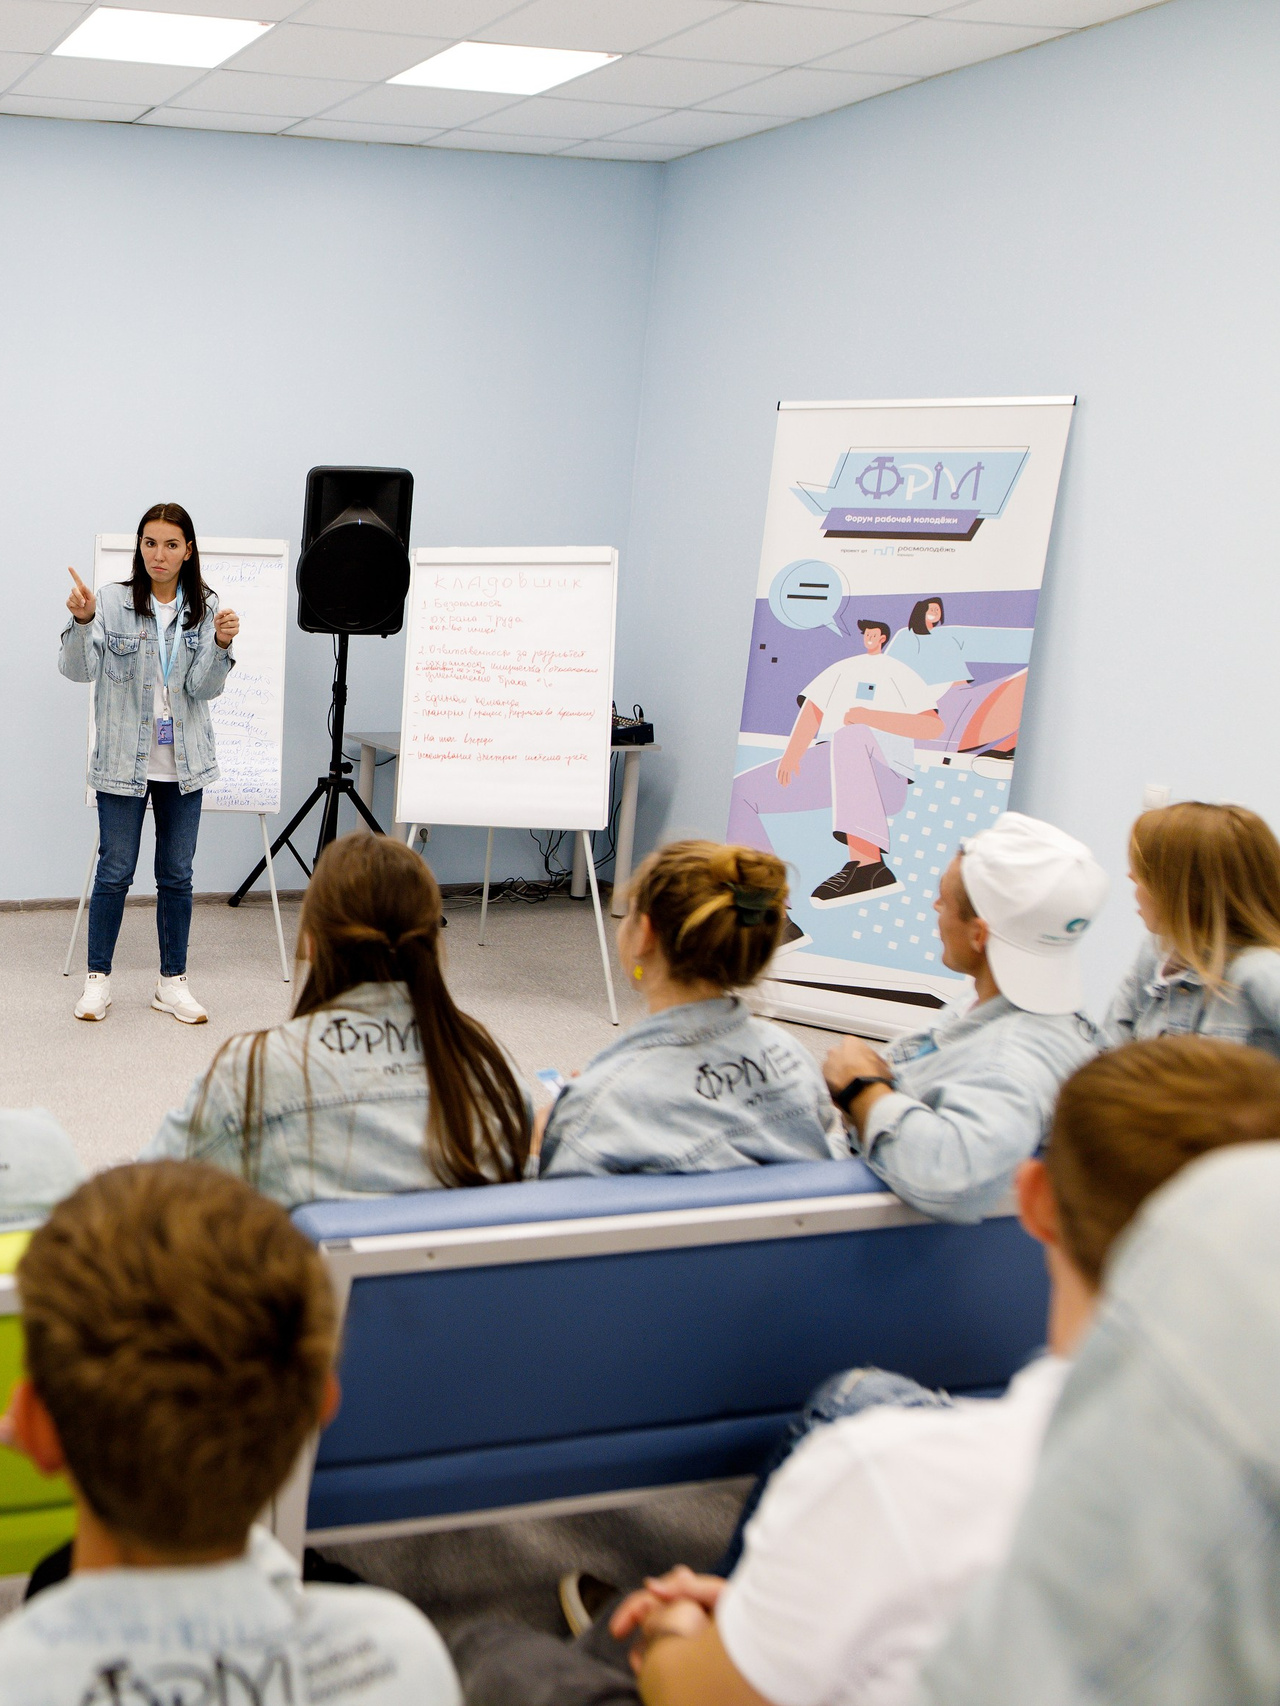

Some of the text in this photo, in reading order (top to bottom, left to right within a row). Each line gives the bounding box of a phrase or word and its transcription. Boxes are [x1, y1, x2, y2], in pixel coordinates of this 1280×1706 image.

[855, 456, 985, 500] ФРМ
[844, 514, 958, 525] Форум рабочей молодёжи
[319, 1017, 421, 1055] ФРМ
[694, 1046, 781, 1101] ФРМ
